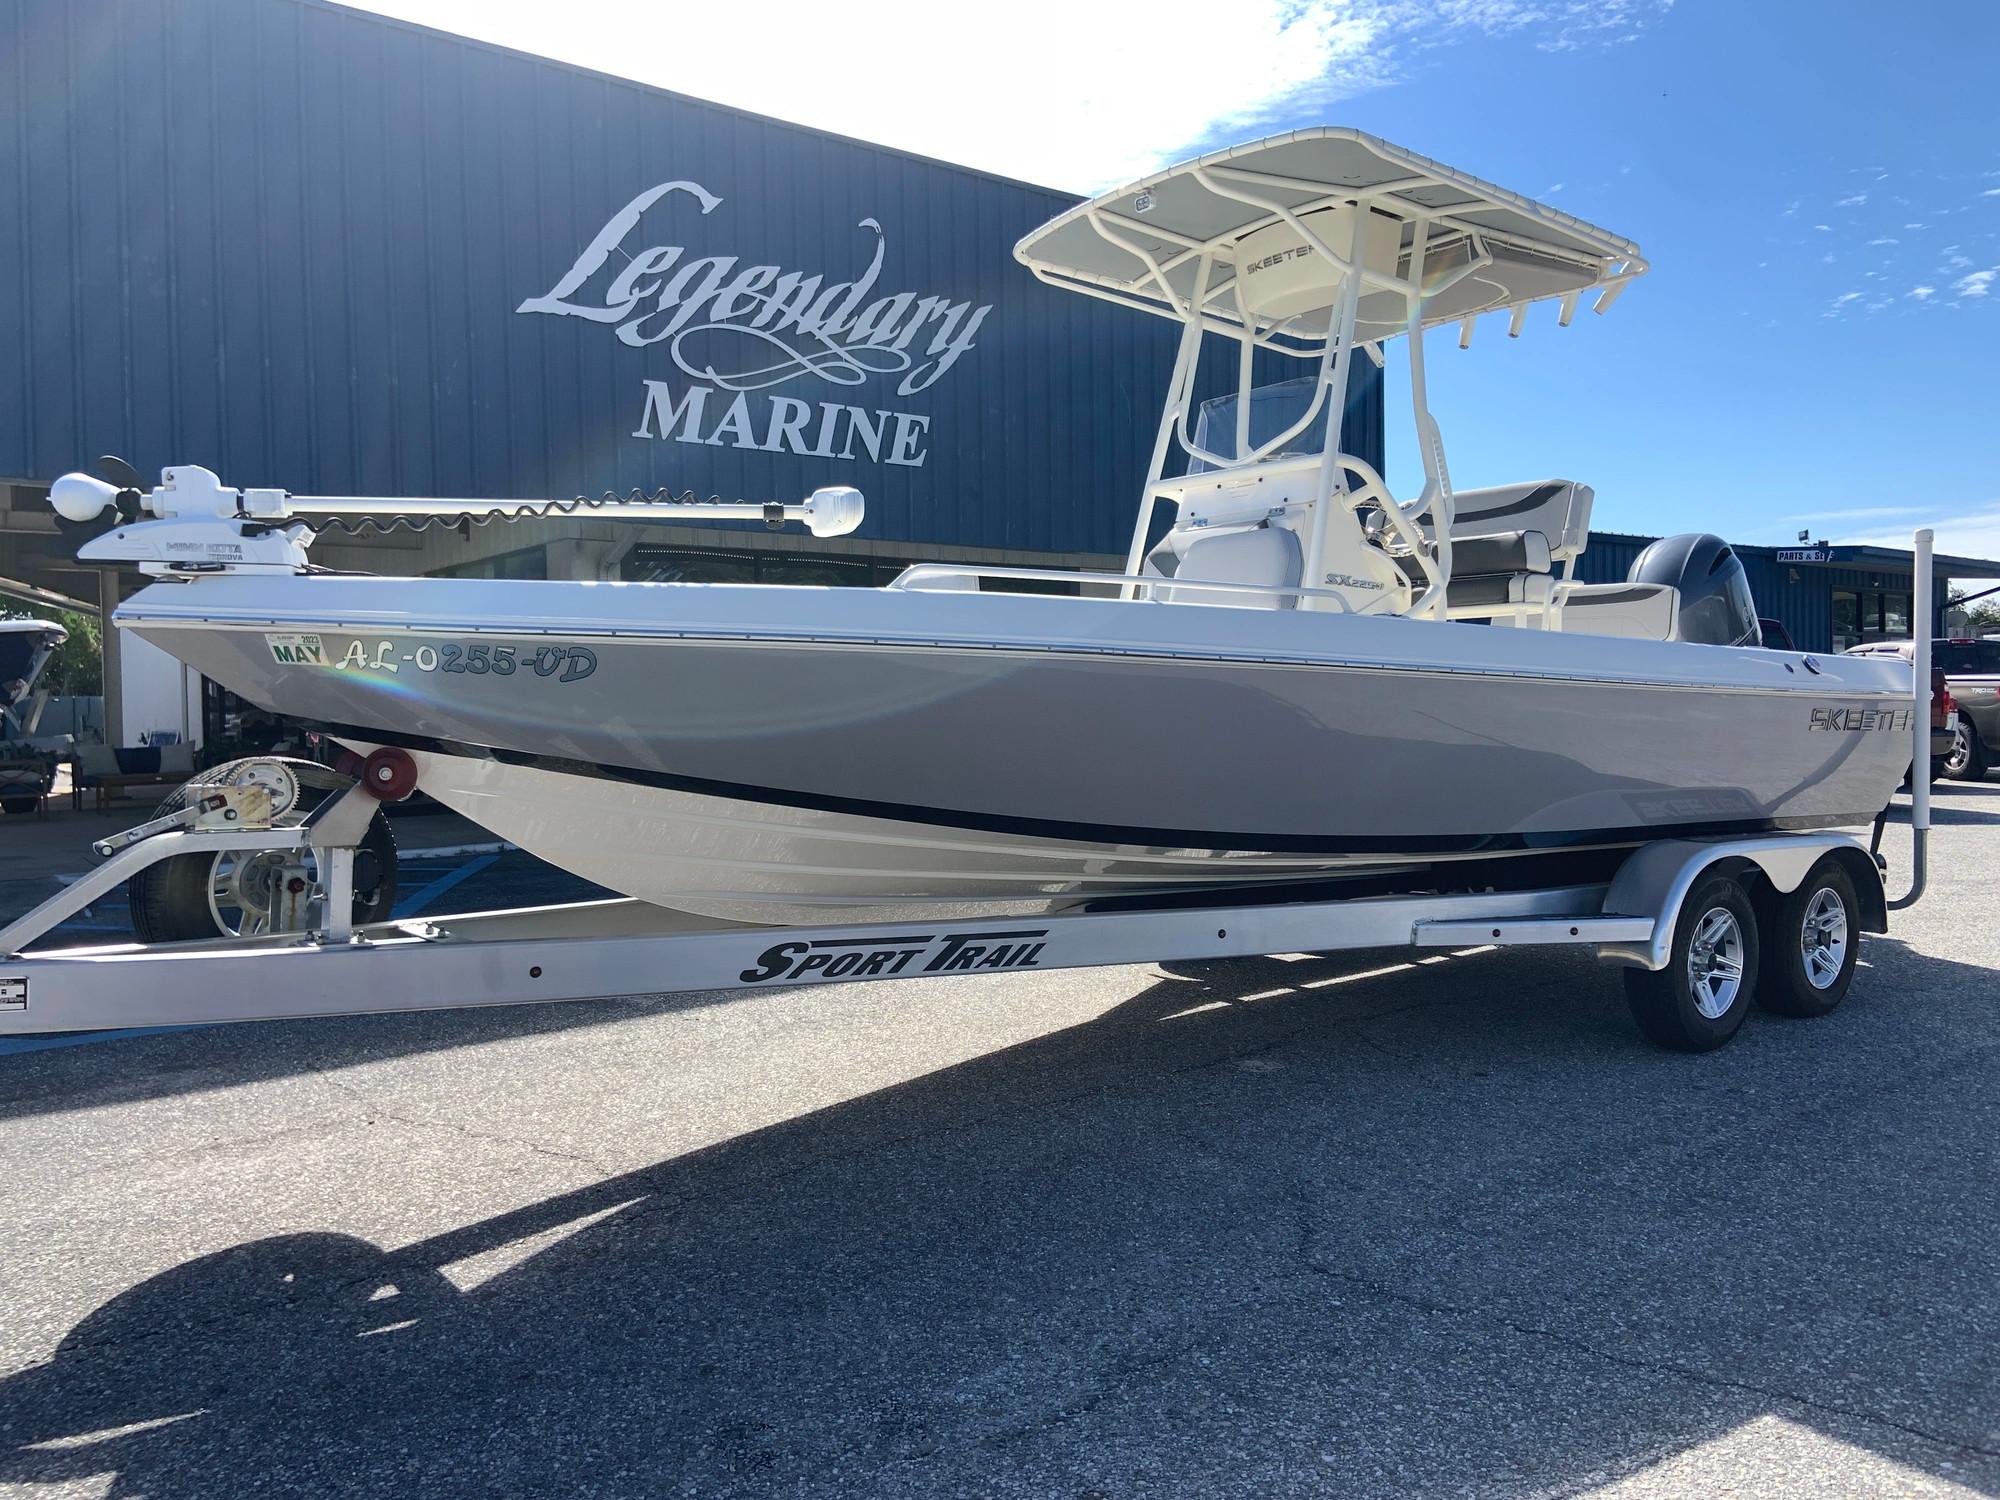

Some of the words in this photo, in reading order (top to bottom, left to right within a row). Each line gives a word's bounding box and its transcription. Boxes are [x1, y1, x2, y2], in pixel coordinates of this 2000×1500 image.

[516, 180, 993, 396] Legendary
[632, 379, 931, 467] MARINE
[1779, 552, 1803, 560] PARTS
[272, 646, 321, 663] MAY
[739, 935, 936, 983] SPORT
[923, 929, 1050, 972] TRAIL
